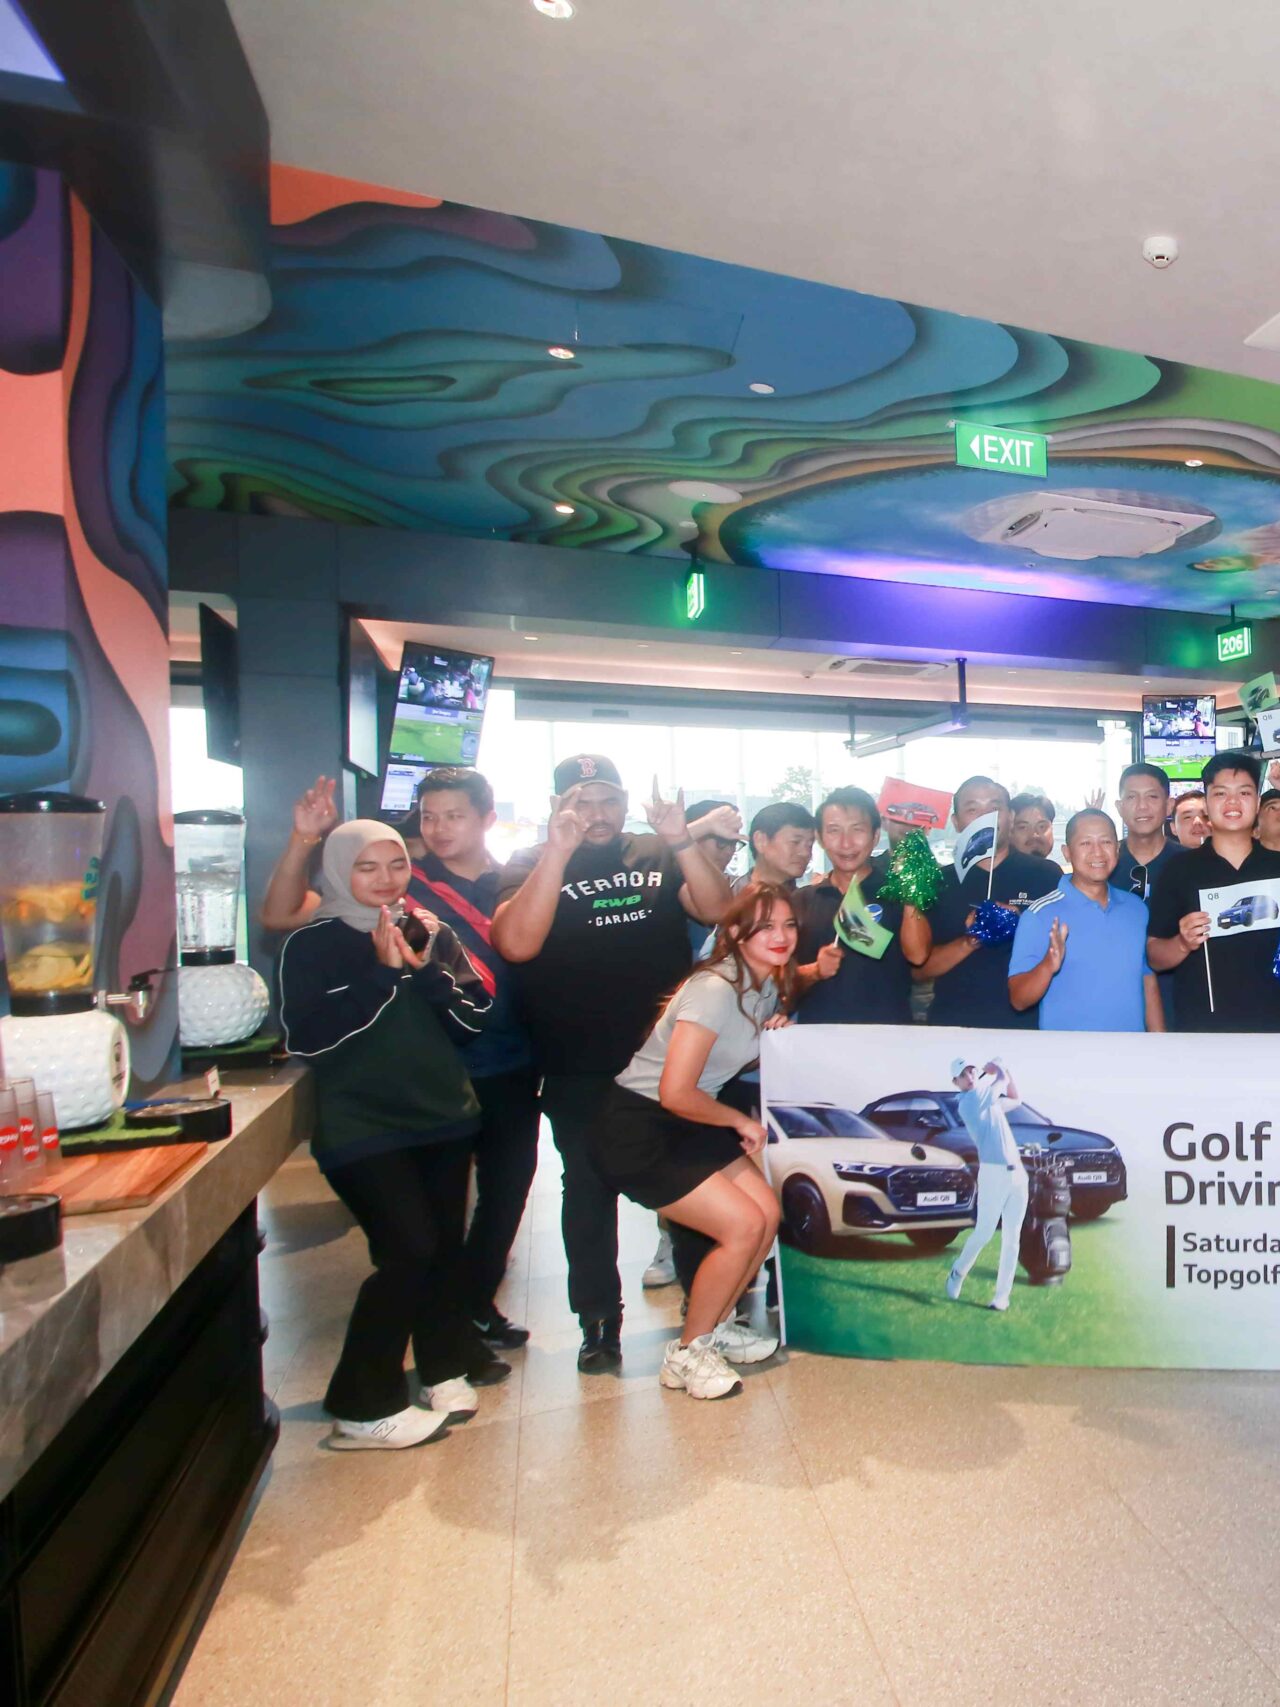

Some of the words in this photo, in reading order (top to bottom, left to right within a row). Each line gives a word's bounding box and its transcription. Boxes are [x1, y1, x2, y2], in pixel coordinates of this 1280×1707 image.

[983, 434, 1034, 468] EXIT
[1222, 634, 1243, 655] 206
[577, 757, 598, 778] B
[561, 871, 663, 900] TERROR
[592, 894, 642, 909] RWB
[1207, 892, 1220, 901] Q8
[595, 909, 647, 927] GARAGE
[1162, 1121, 1272, 1161] Golf
[1183, 1263, 1280, 1290] Topgolf
